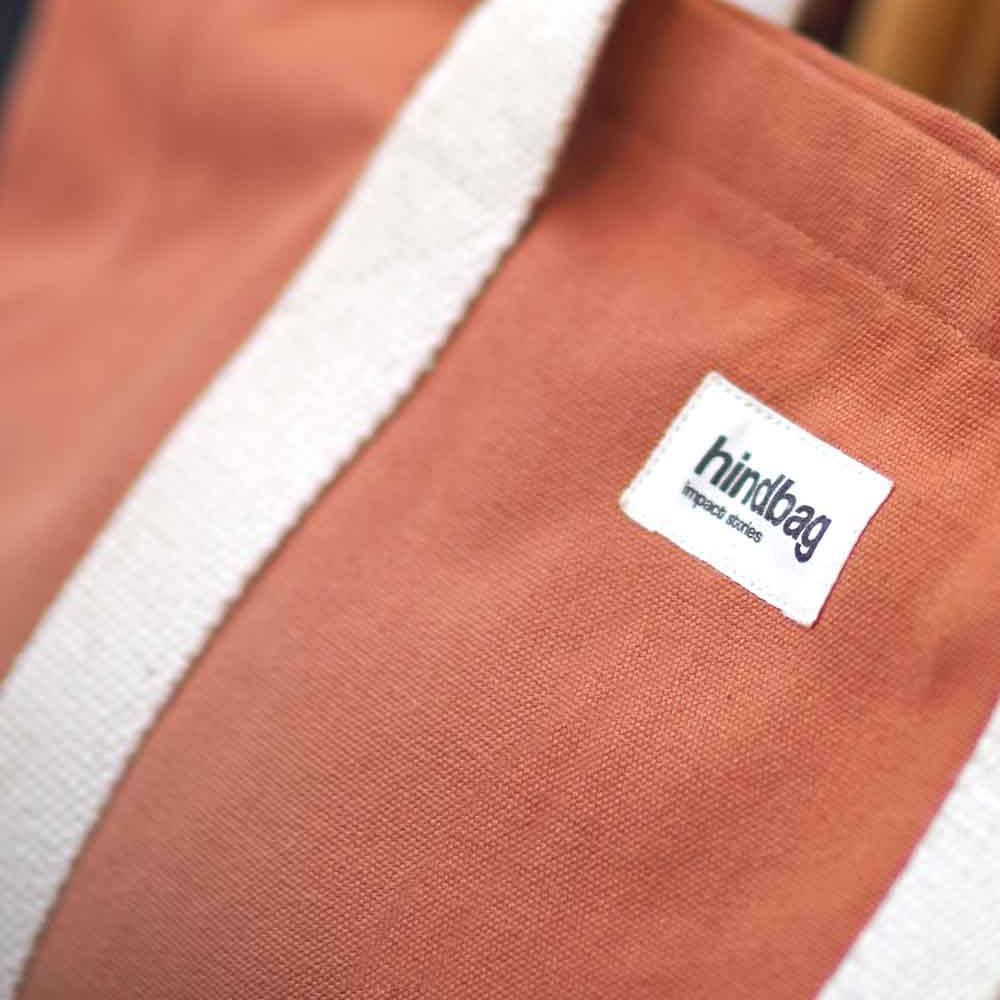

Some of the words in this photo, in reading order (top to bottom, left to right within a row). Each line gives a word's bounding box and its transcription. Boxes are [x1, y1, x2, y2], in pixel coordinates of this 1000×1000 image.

[682, 480, 727, 520] impact
[726, 514, 763, 543] stories
[693, 434, 832, 563] hindbag
